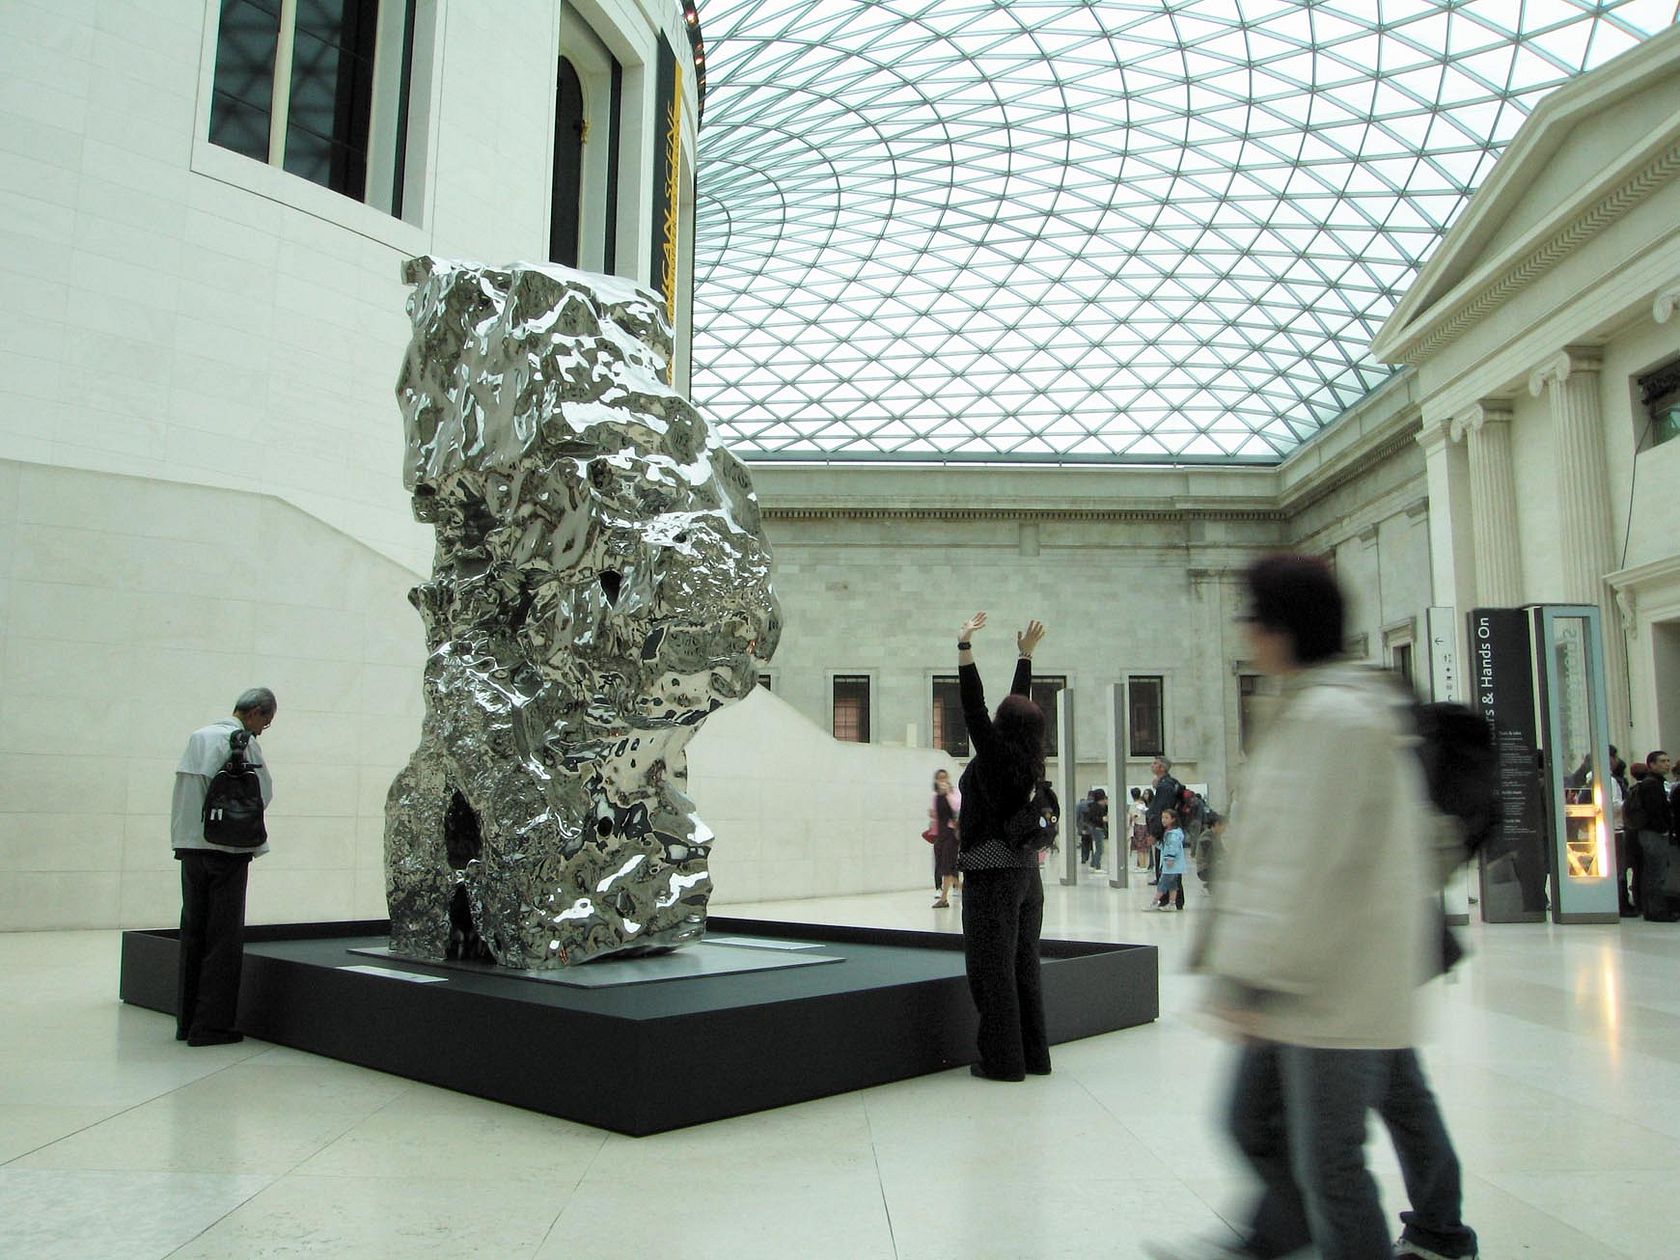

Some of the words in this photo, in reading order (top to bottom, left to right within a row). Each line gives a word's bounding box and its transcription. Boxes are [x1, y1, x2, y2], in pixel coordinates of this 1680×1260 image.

[664, 99, 679, 199] SCENE
[662, 208, 677, 303] ICAN
[1478, 617, 1490, 639] On
[1478, 643, 1493, 688] Hands
[1481, 692, 1494, 705] &
